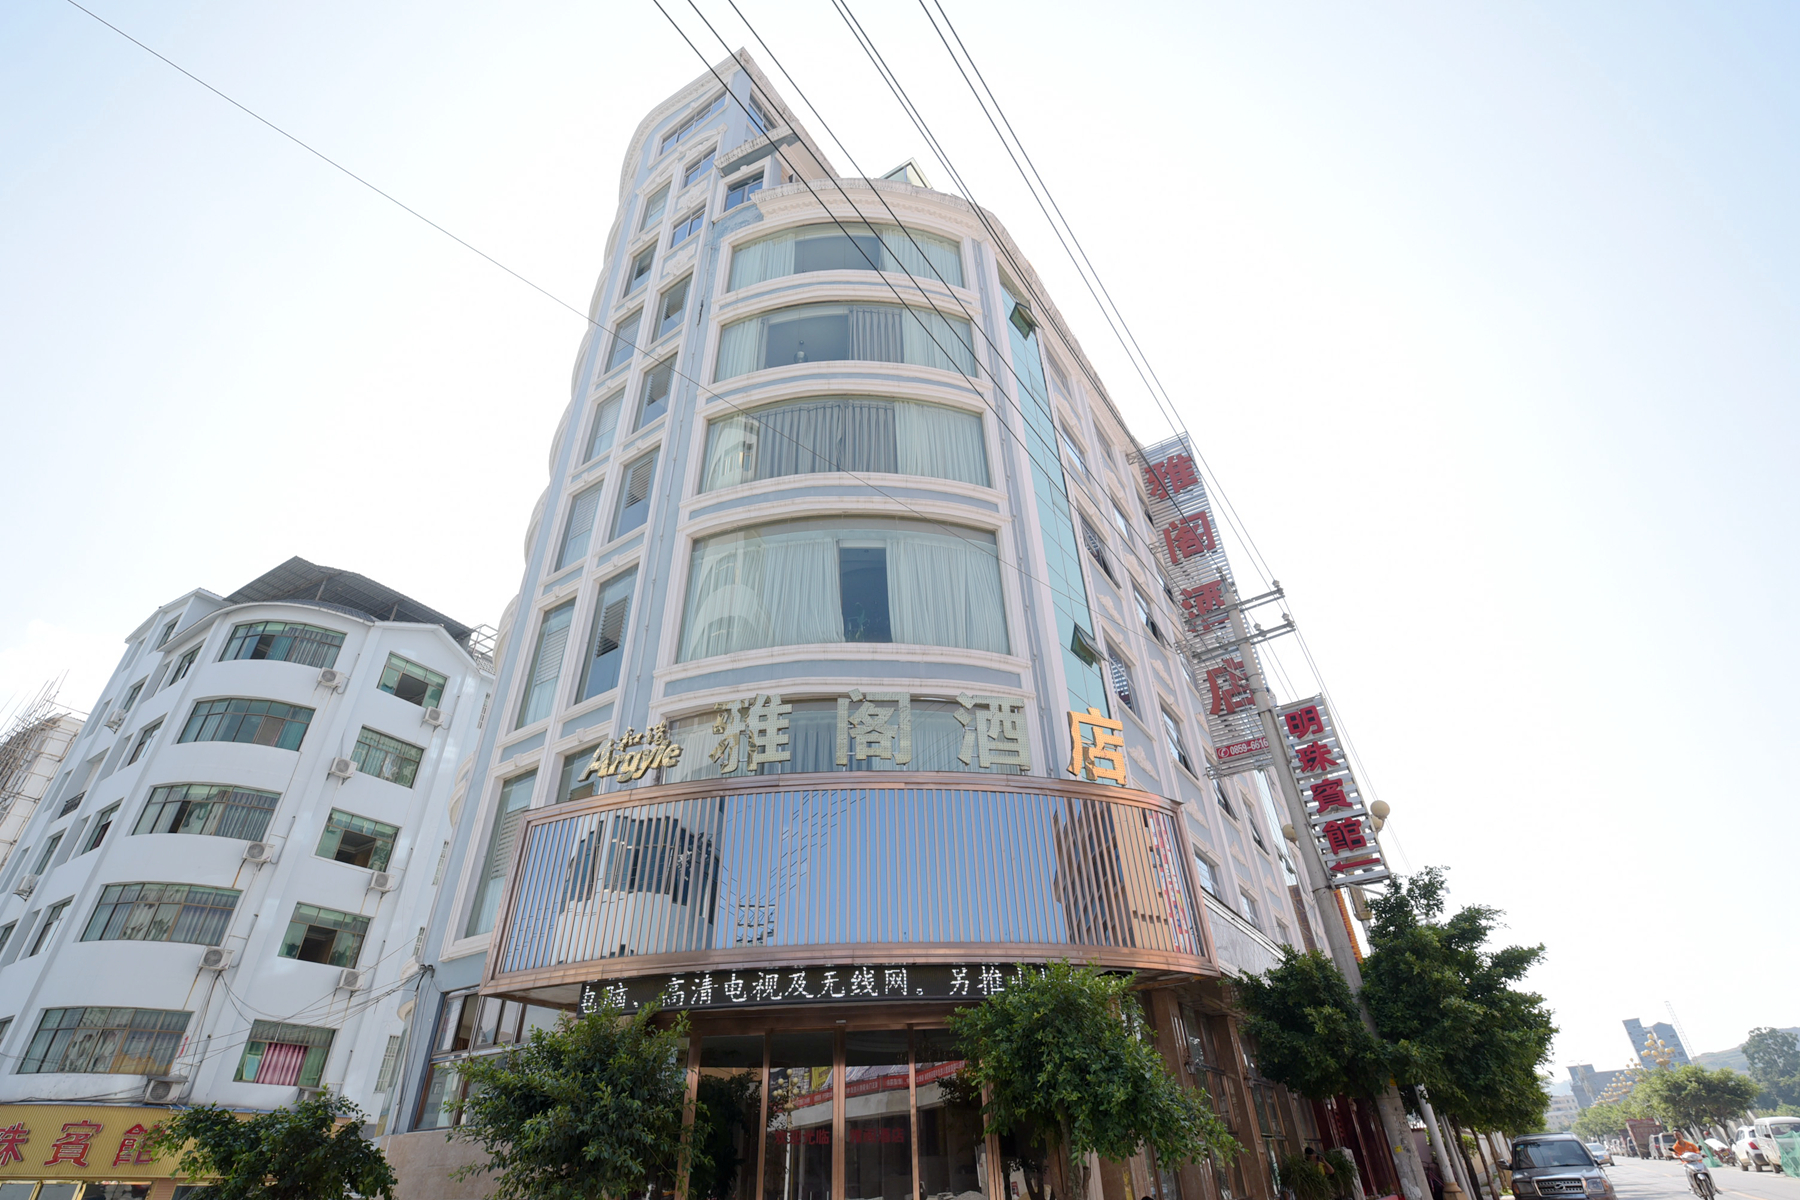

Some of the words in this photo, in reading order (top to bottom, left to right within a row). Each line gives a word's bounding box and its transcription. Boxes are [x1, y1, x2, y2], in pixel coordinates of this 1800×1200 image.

[577, 738, 683, 783] Argyle
[709, 688, 1127, 786] 雅阁酒店
[1284, 705, 1367, 855] 明珠賓館
